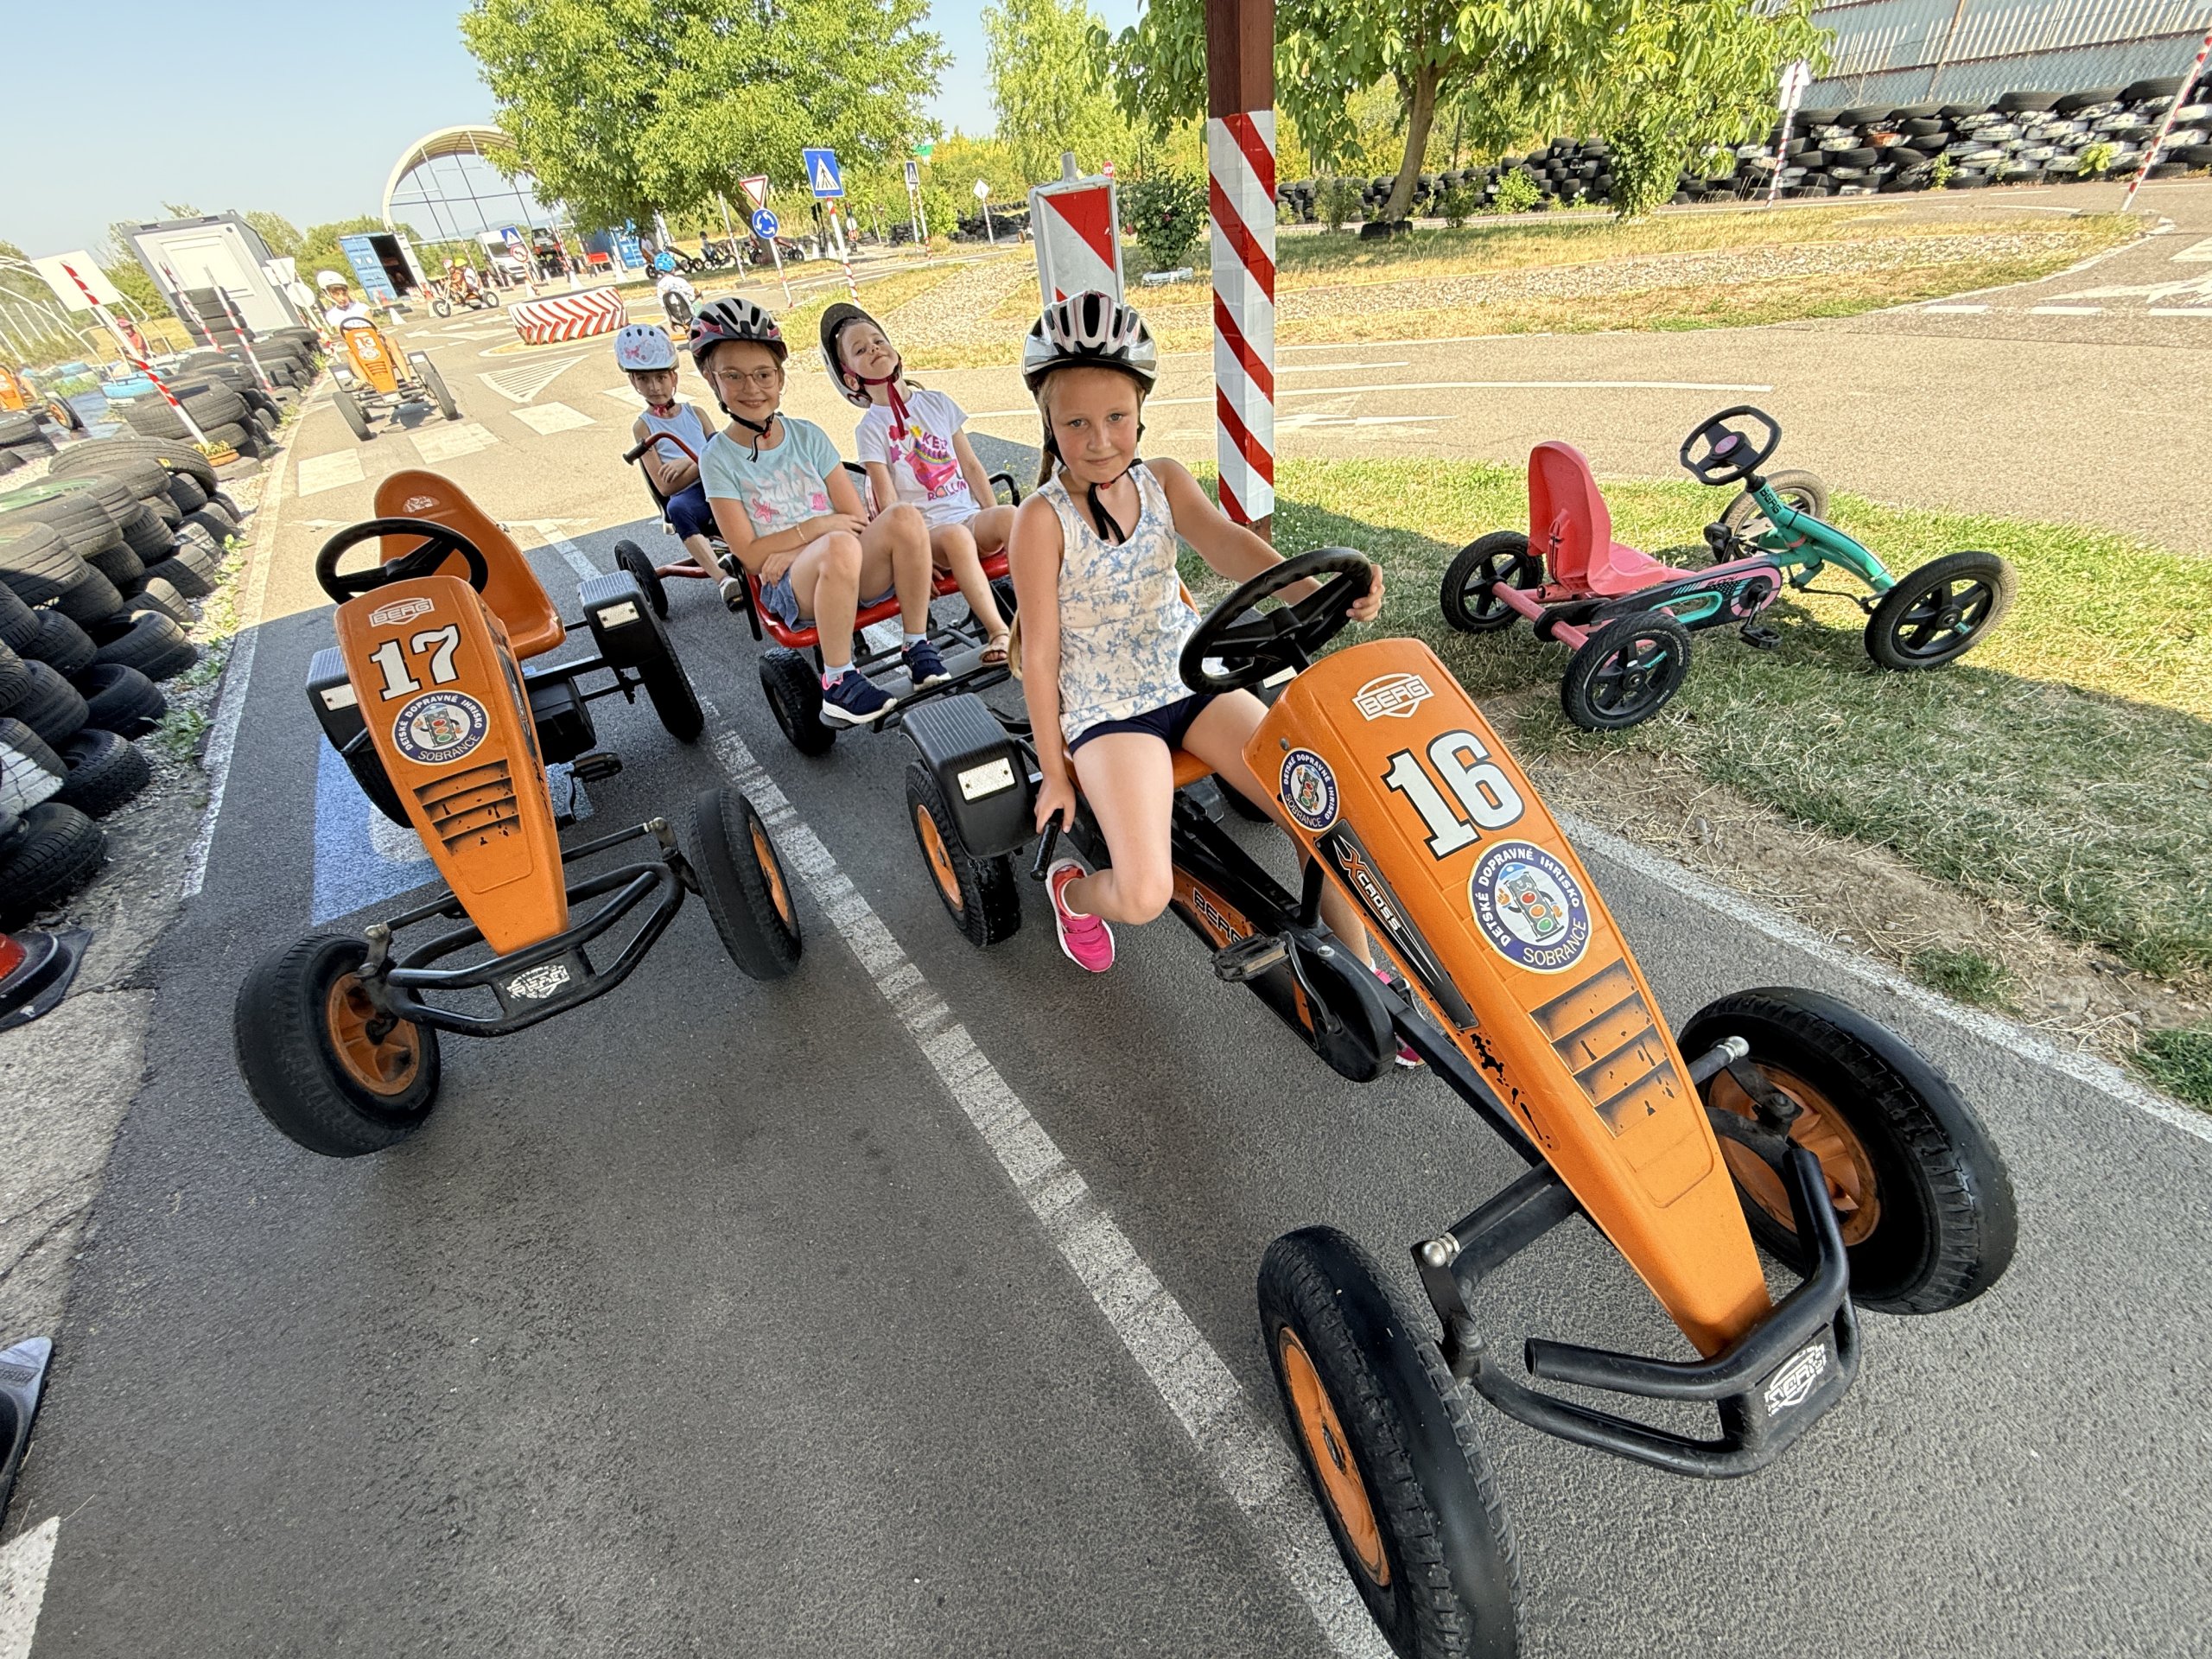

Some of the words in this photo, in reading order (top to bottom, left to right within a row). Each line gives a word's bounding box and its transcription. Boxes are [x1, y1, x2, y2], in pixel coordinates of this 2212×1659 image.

[355, 336, 377, 349] 13
[1759, 488, 1782, 514] BERG
[372, 599, 431, 624] BERG
[369, 623, 461, 702] 17
[405, 695, 458, 718] DOPRAVNÉ
[461, 699, 482, 728] IHRISKO
[1360, 679, 1427, 716] BERG
[398, 720, 414, 751] DETSKÉ
[418, 734, 480, 761] SOBRANCE
[1285, 793, 1324, 827] SOBRANCE
[1325, 786, 1335, 820] IHRISKO
[1380, 729, 1525, 861] 16
[1478, 847, 1535, 887] DOPRAVNÉ
[1540, 856, 1580, 907] IHRISKO
[1475, 892, 1512, 947] DETSKÉ
[1522, 918, 1586, 965] SOBRANCE
